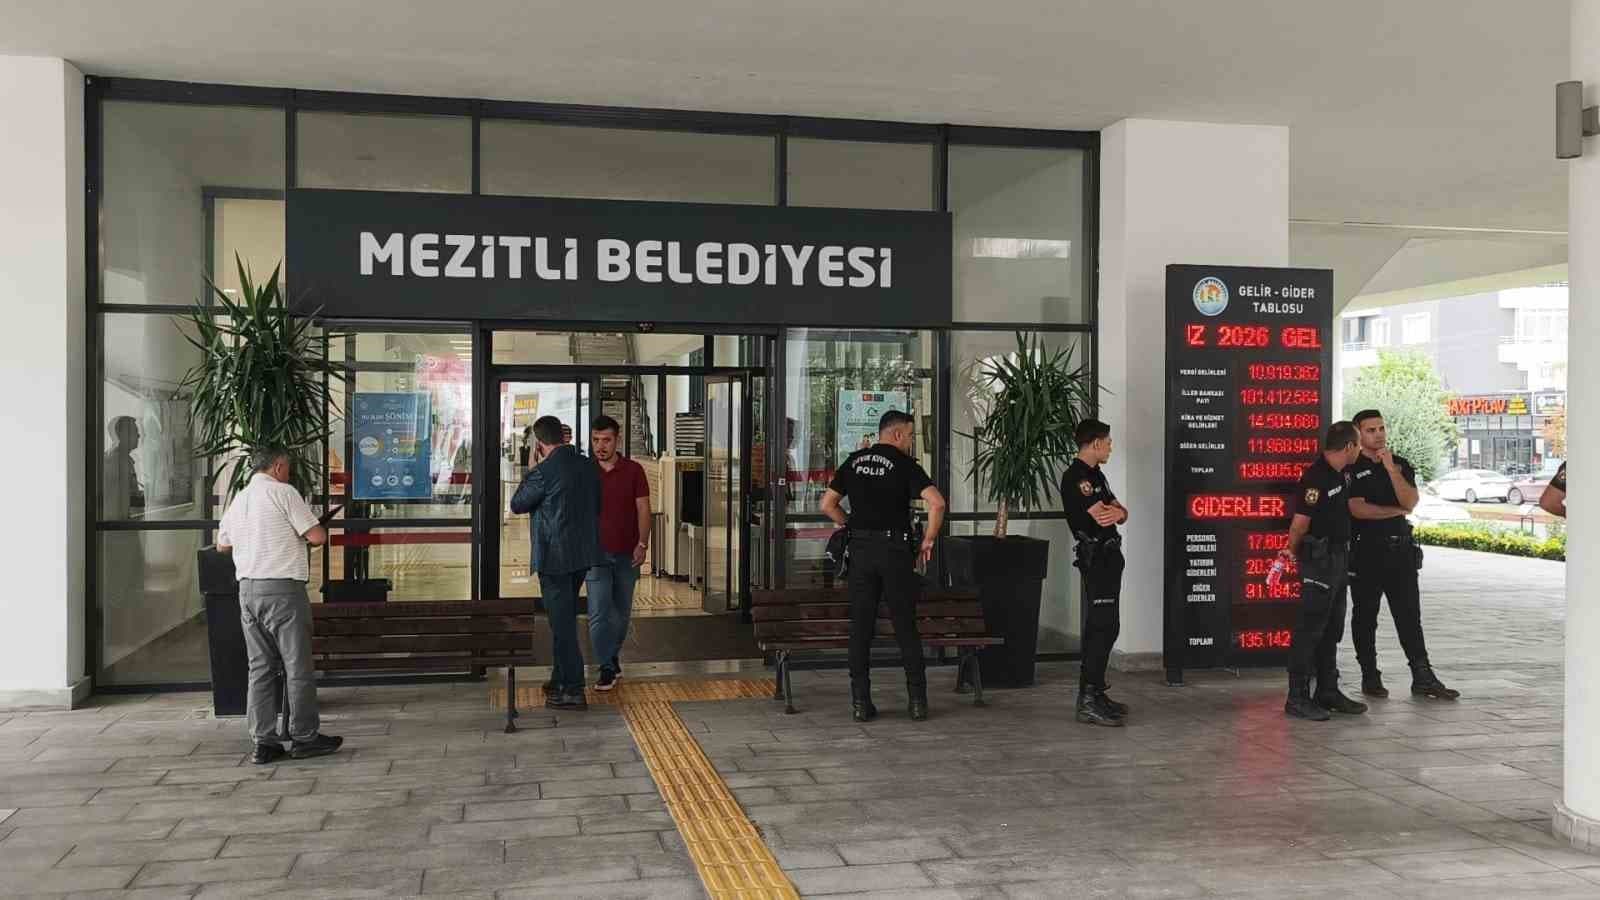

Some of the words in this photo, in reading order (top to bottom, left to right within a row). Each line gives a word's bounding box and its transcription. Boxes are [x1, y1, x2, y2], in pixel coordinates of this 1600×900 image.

[360, 231, 578, 280] MEZİTLİ
[597, 238, 891, 288] BELEDİYESİ
[1239, 283, 1271, 297] GELİR
[1281, 284, 1315, 299] GİDER
[1252, 302, 1303, 314] TABLOSU
[1218, 325, 1268, 346] 2026
[1189, 637, 1213, 646] TOPLAM
